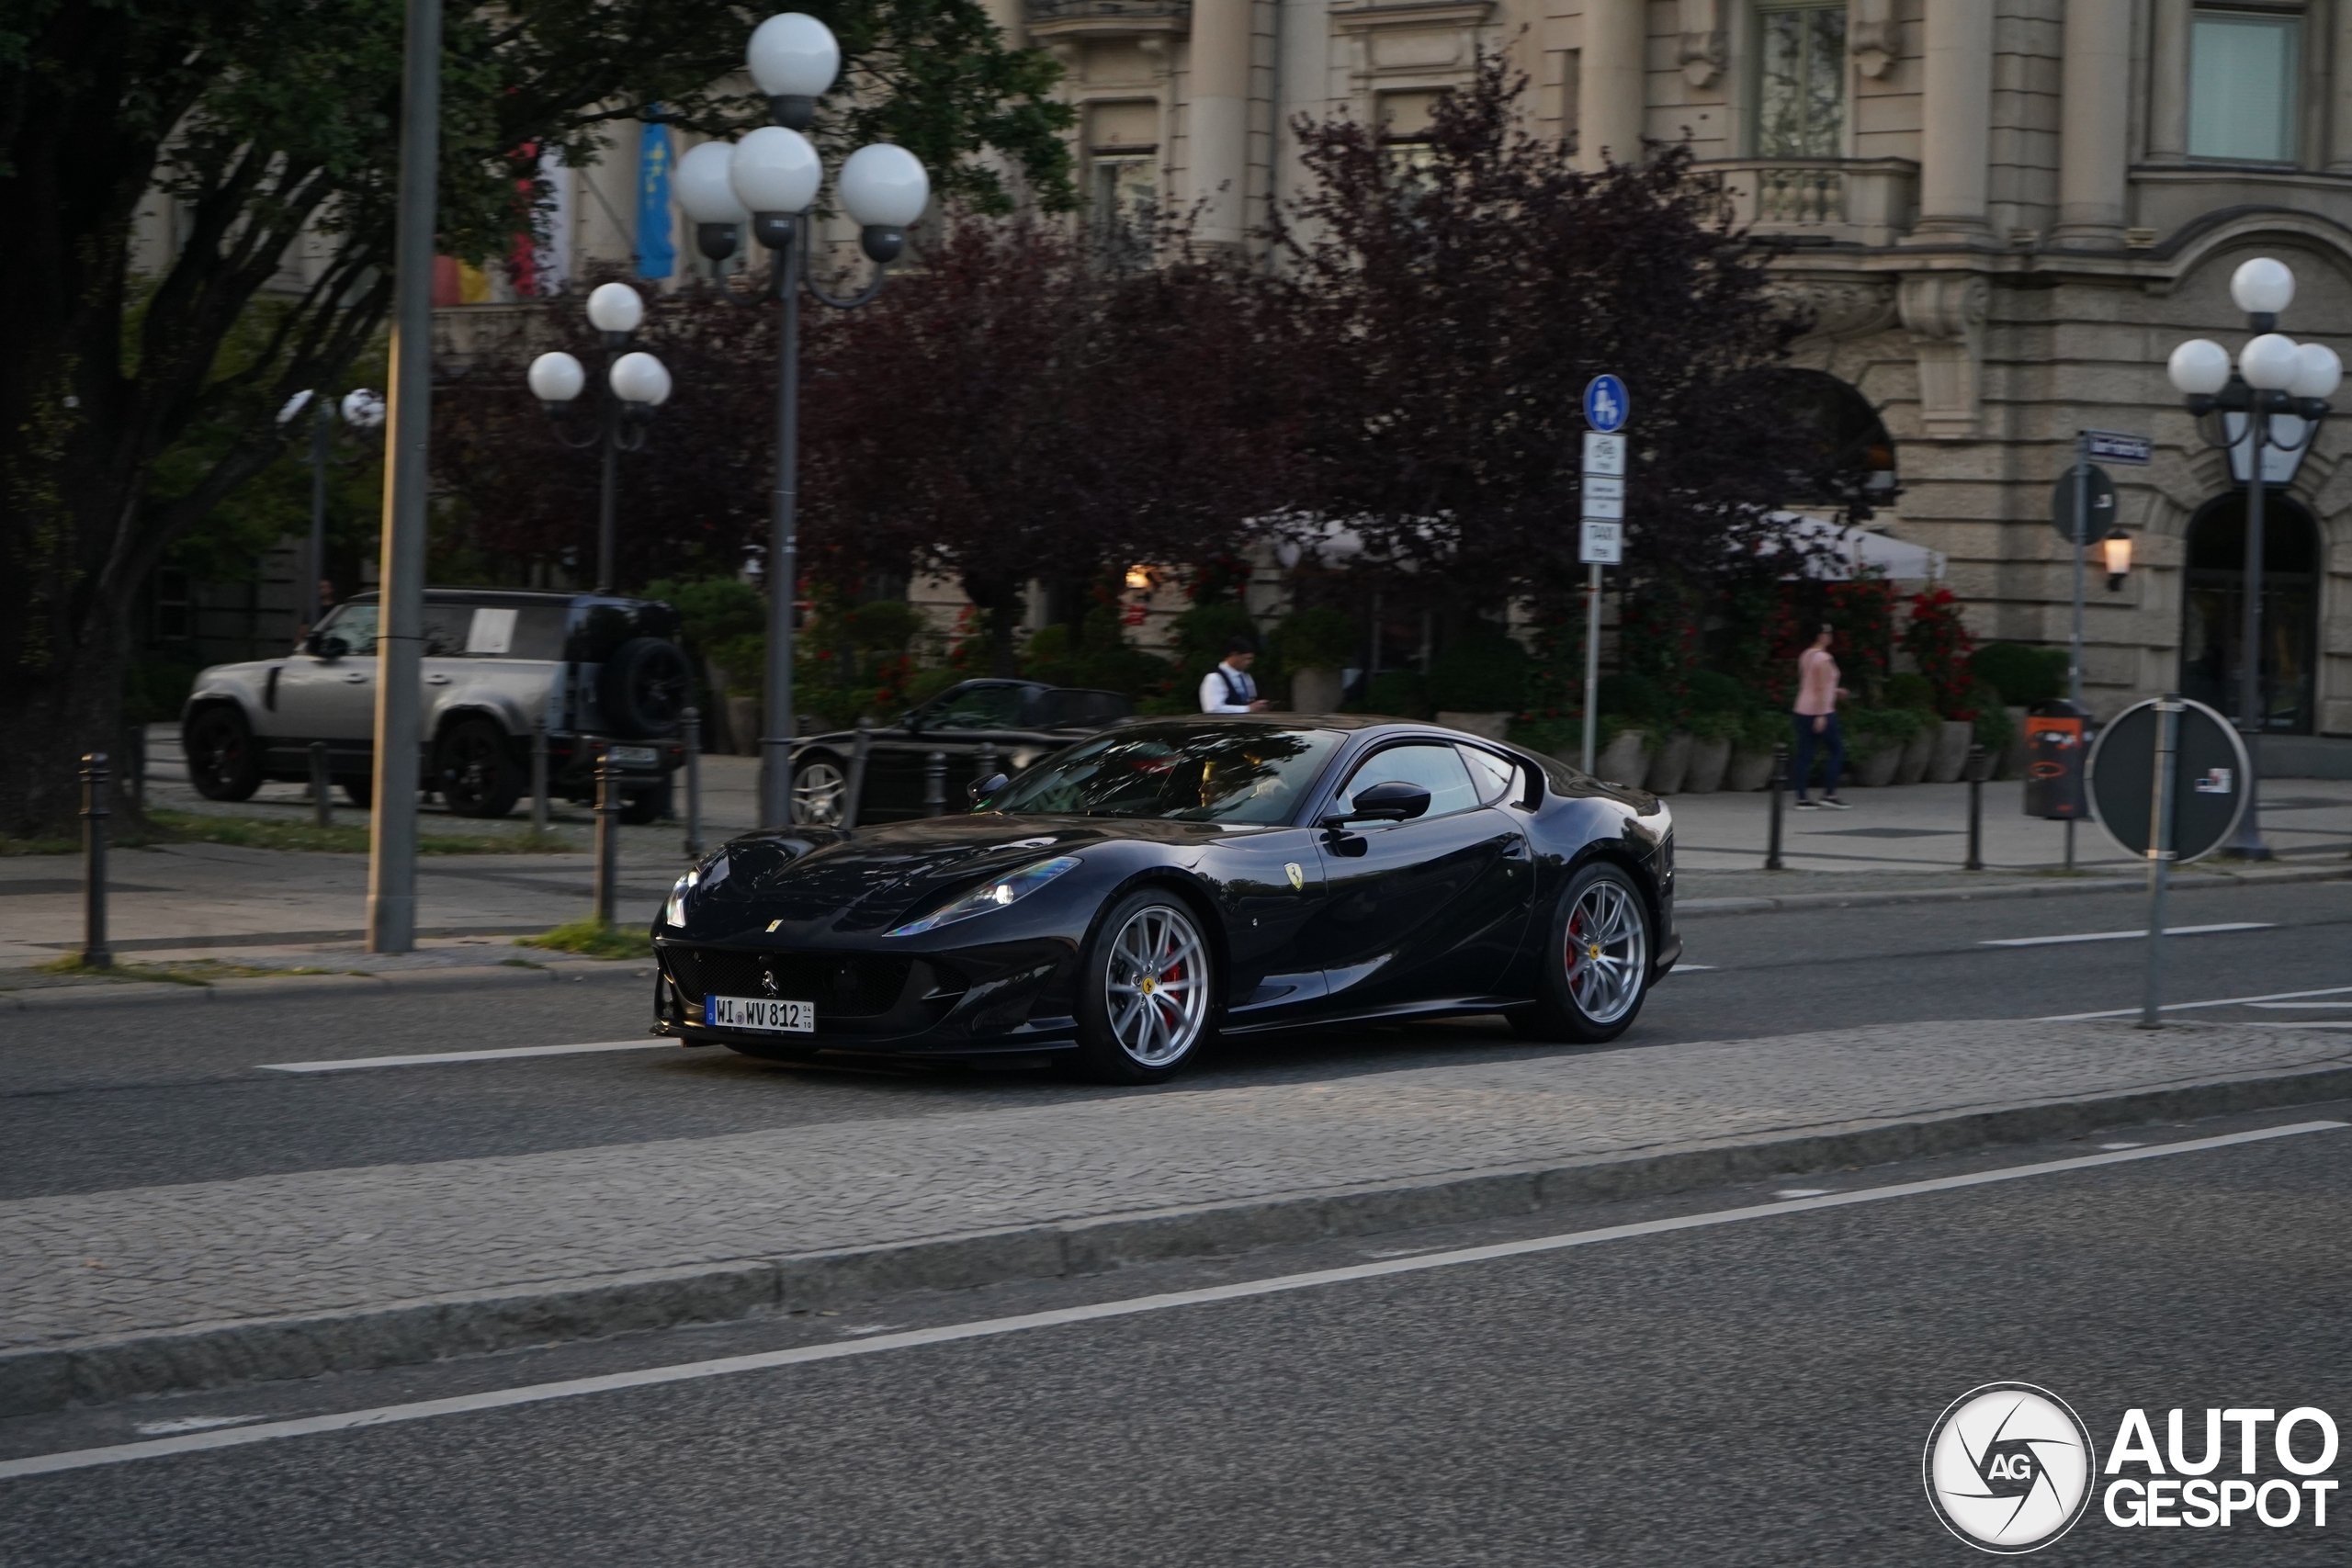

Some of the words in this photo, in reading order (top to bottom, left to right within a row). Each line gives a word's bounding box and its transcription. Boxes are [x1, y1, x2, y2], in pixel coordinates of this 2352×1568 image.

[717, 999, 733, 1023] WI
[746, 1001, 765, 1025] WV
[769, 1003, 799, 1028] 812
